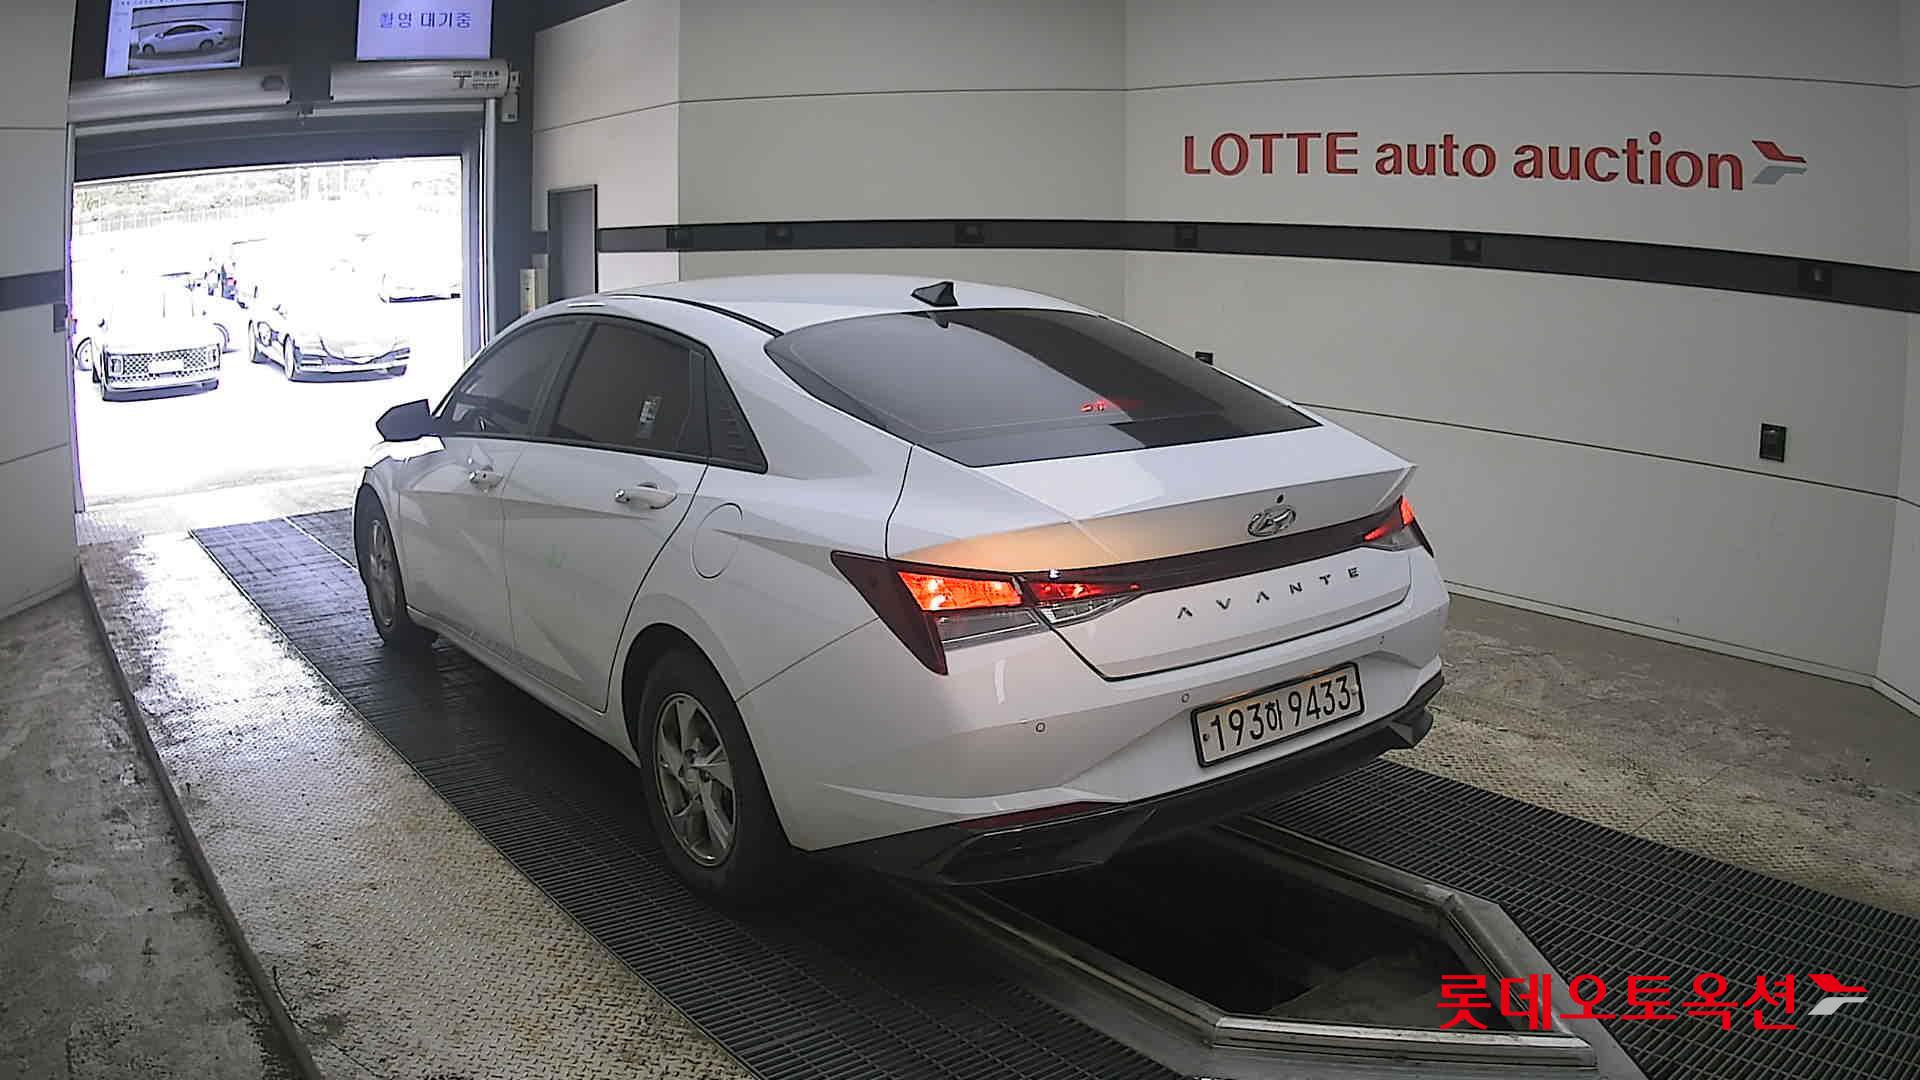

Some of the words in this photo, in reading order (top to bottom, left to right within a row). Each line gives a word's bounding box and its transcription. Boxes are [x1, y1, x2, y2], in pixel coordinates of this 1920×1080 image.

[420, 12, 472, 29] 대기중
[1184, 131, 1359, 176] LOTTE
[1375, 134, 1497, 177] auto
[1513, 131, 1743, 190] auction
[1177, 567, 1360, 619] AVANTE
[1210, 699, 1284, 751] 193하
[1288, 674, 1351, 727] 9433
